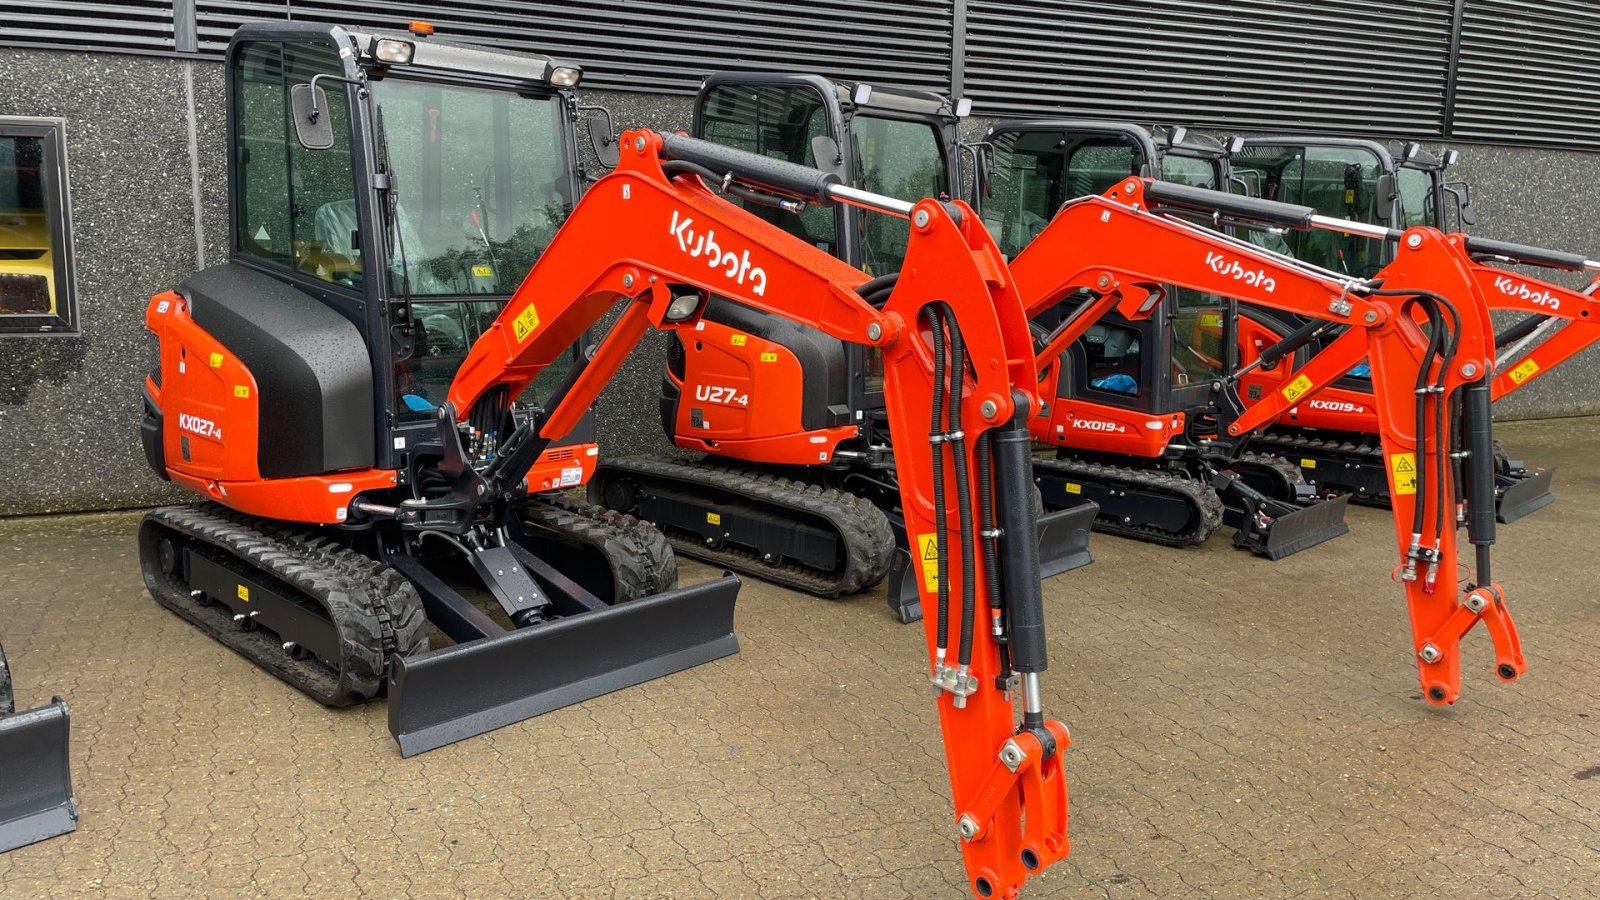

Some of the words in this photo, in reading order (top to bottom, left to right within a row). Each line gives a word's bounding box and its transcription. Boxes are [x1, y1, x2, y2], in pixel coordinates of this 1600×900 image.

[669, 210, 767, 296] Kubota
[1205, 251, 1276, 293] Kubota
[1494, 276, 1561, 310] Kubota
[696, 385, 748, 406] U27-4
[1309, 399, 1364, 413] KX019-4
[179, 413, 222, 440] KX027-4
[1072, 419, 1126, 433] KX019-4
